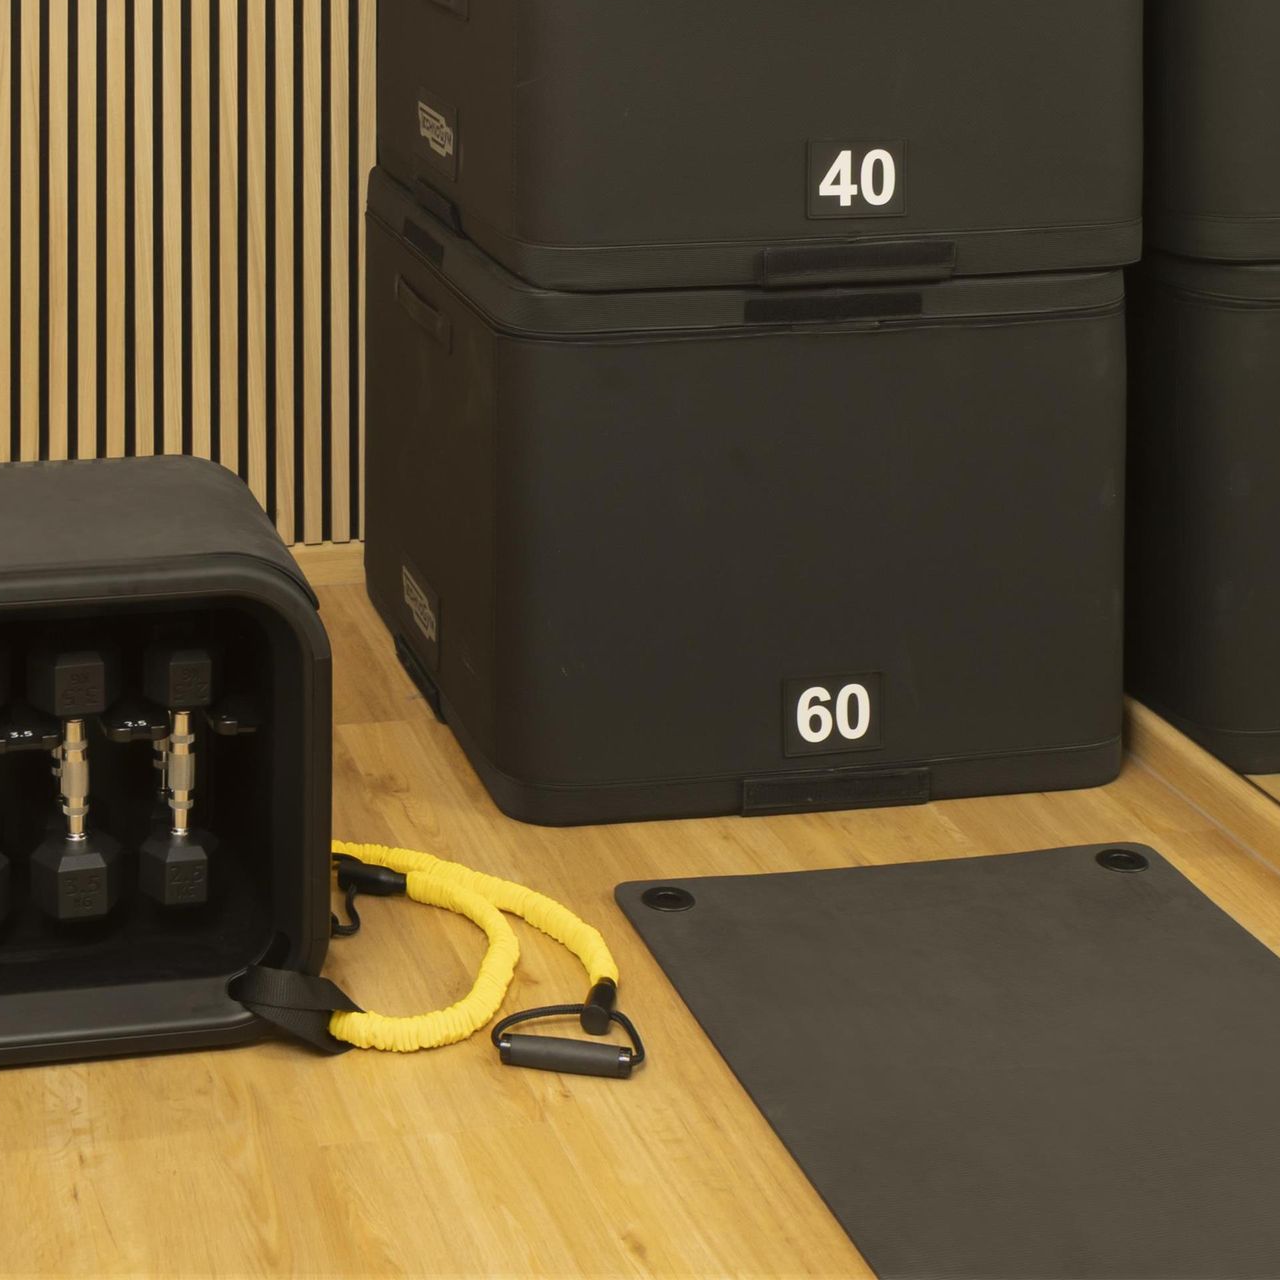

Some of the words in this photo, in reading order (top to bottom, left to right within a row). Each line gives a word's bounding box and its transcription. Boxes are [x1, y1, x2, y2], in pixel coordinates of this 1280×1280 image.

[818, 149, 895, 206] 40
[9, 730, 33, 739] 3.5
[797, 683, 871, 742] 60
